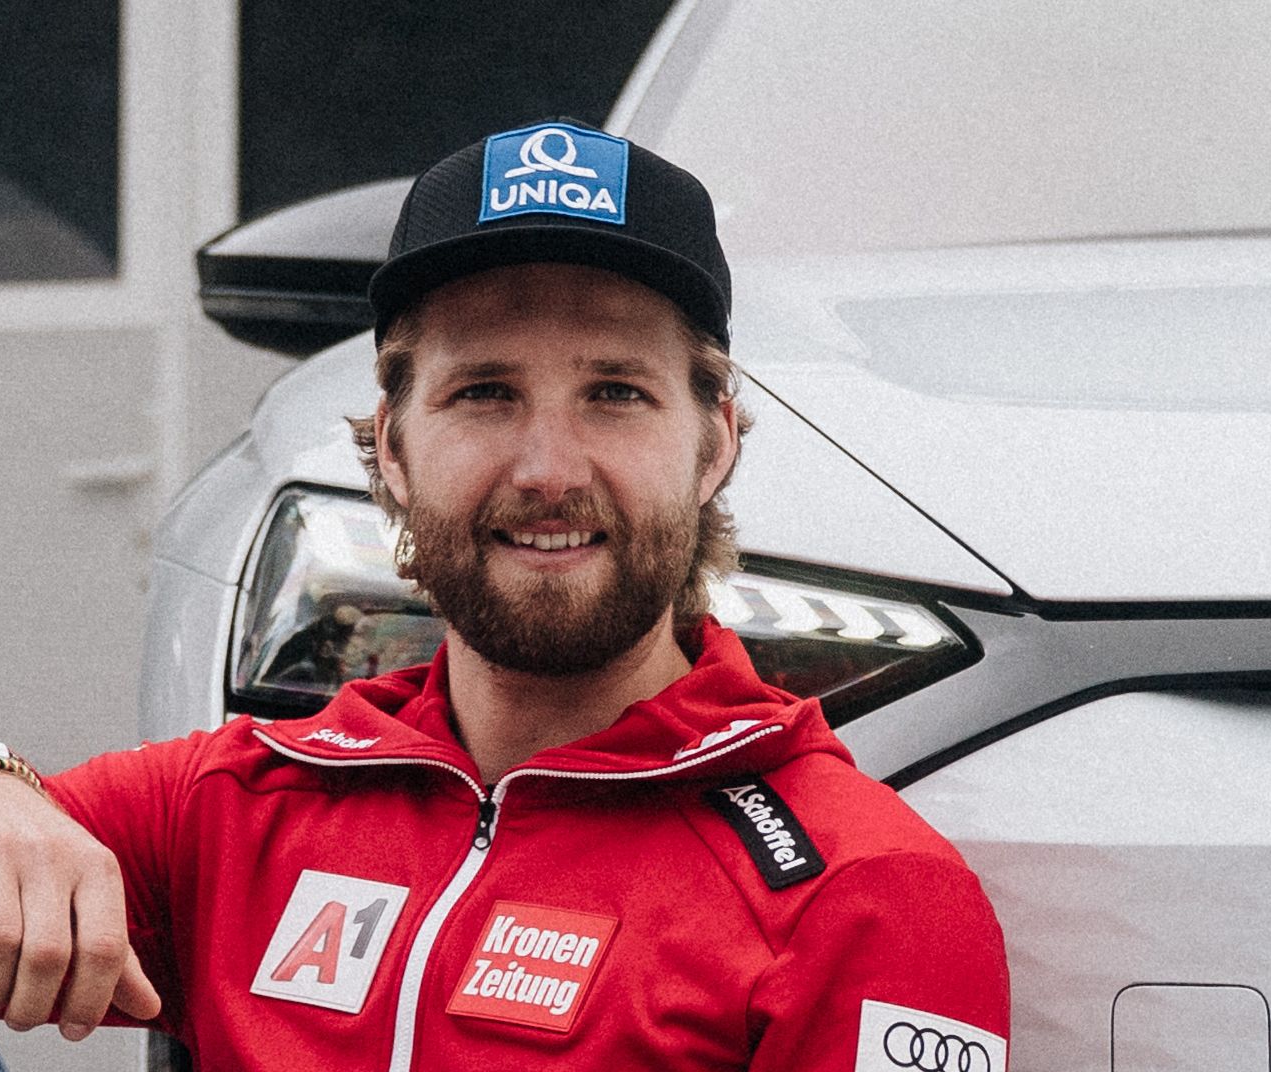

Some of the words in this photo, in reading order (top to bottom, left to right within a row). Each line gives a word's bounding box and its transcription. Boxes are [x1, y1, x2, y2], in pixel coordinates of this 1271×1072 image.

[490, 179, 618, 214] UNIQA
[736, 793, 807, 872] Schöffel
[270, 898, 388, 985] A1
[481, 914, 600, 968] Kronen
[462, 959, 580, 1015] Zeitung
